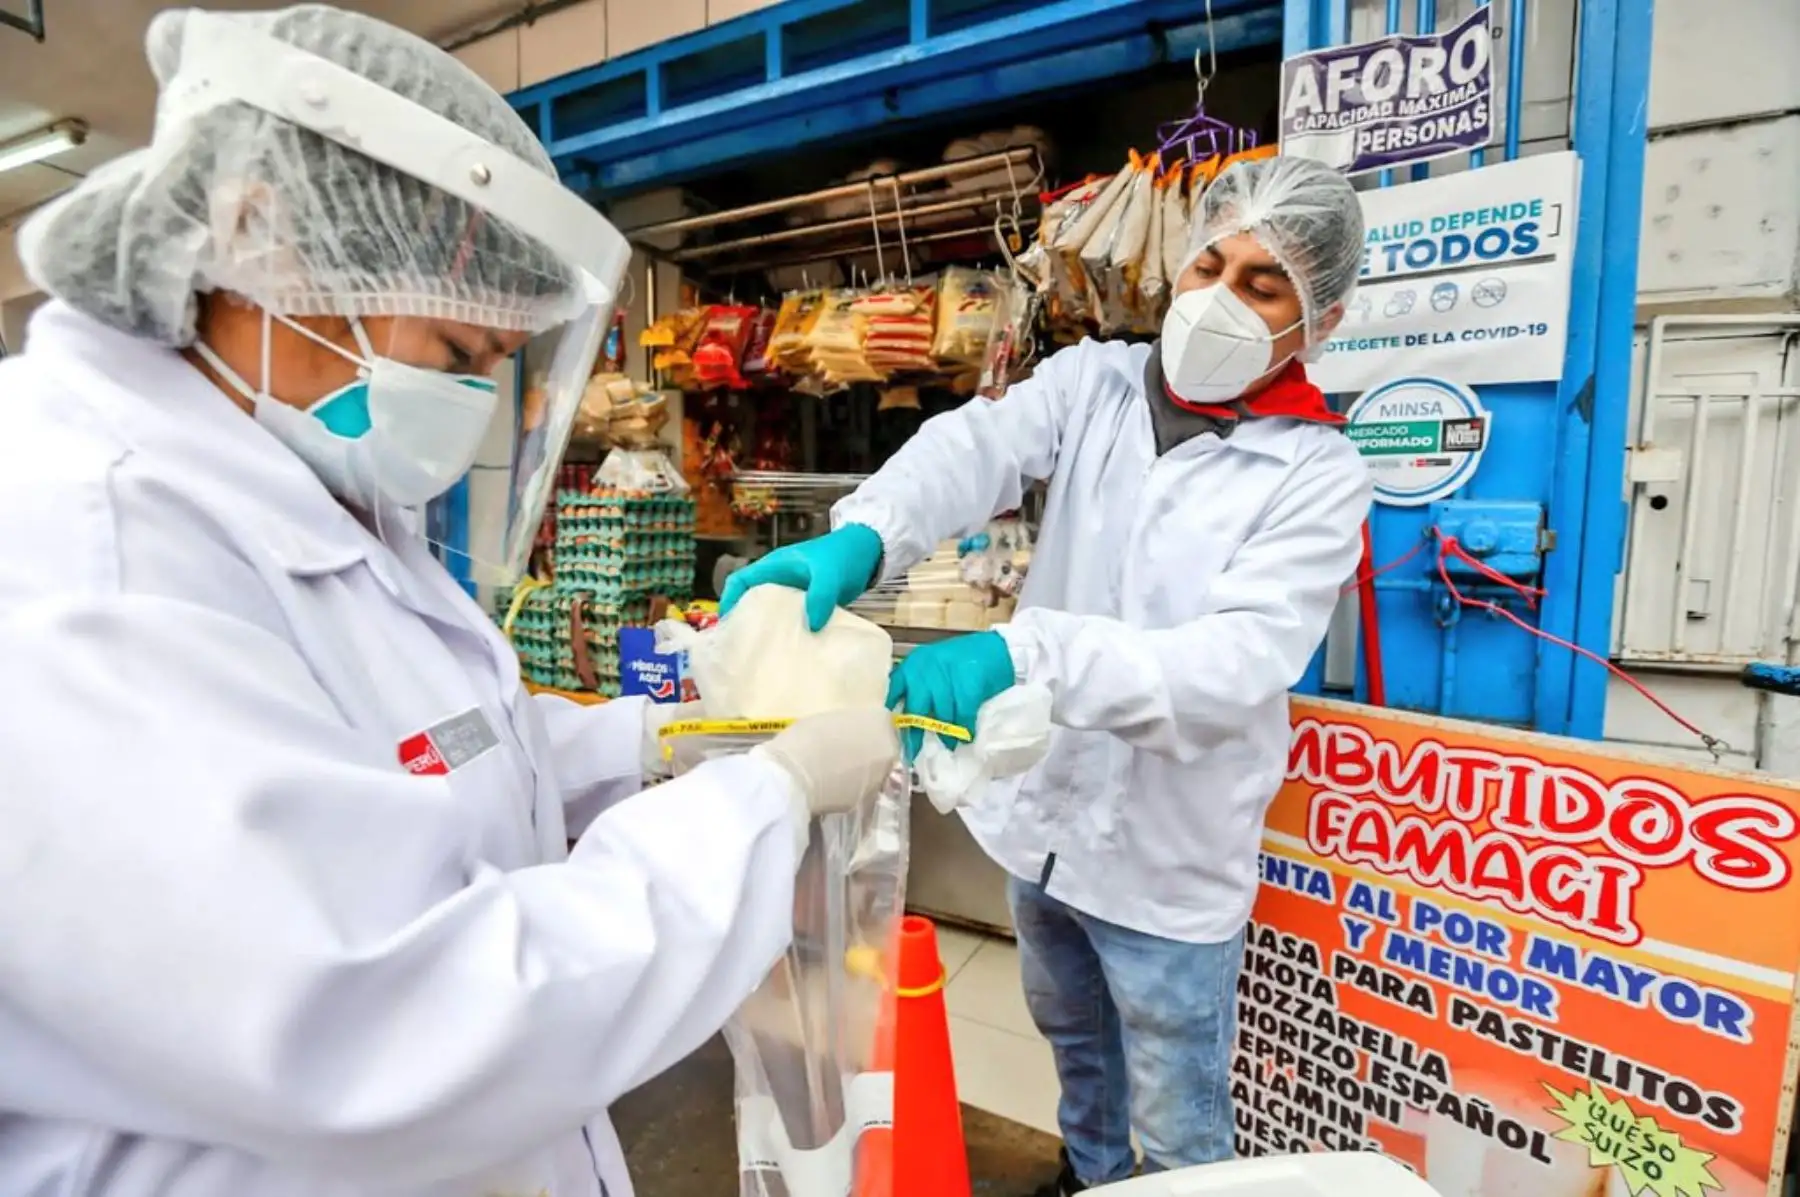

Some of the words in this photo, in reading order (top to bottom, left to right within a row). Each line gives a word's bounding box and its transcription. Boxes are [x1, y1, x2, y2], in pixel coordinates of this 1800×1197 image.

[1284, 22, 1490, 120] AFORO
[1293, 103, 1393, 131] CAPACIDAD
[1357, 104, 1488, 154] PERSONAS
[1382, 222, 1540, 272] TODOS
[1431, 199, 1543, 234] DEPENDE
[1405, 332, 1427, 347] DE
[1433, 331, 1455, 345] LA
[1461, 323, 1548, 341] COVID-19
[1380, 401, 1444, 417] MINSA
[1344, 918, 1370, 949] Y
[1386, 932, 1556, 1017] MENOR
[1348, 882, 1396, 921] AL
[1415, 902, 1507, 956] POR
[1528, 937, 1749, 1037] MAYOR
[1335, 954, 1433, 1014] PARA
[1452, 997, 1736, 1130] PASTELITOS
[1233, 1055, 1363, 1135] ALAMIN
[1238, 1002, 1354, 1070] HORIZO
[1372, 1054, 1551, 1164] ESPAÑOL
[1239, 1029, 1401, 1124] EPPERONI
[1581, 1122, 1663, 1181] SUIZO
[1588, 1102, 1676, 1163] QUESO
